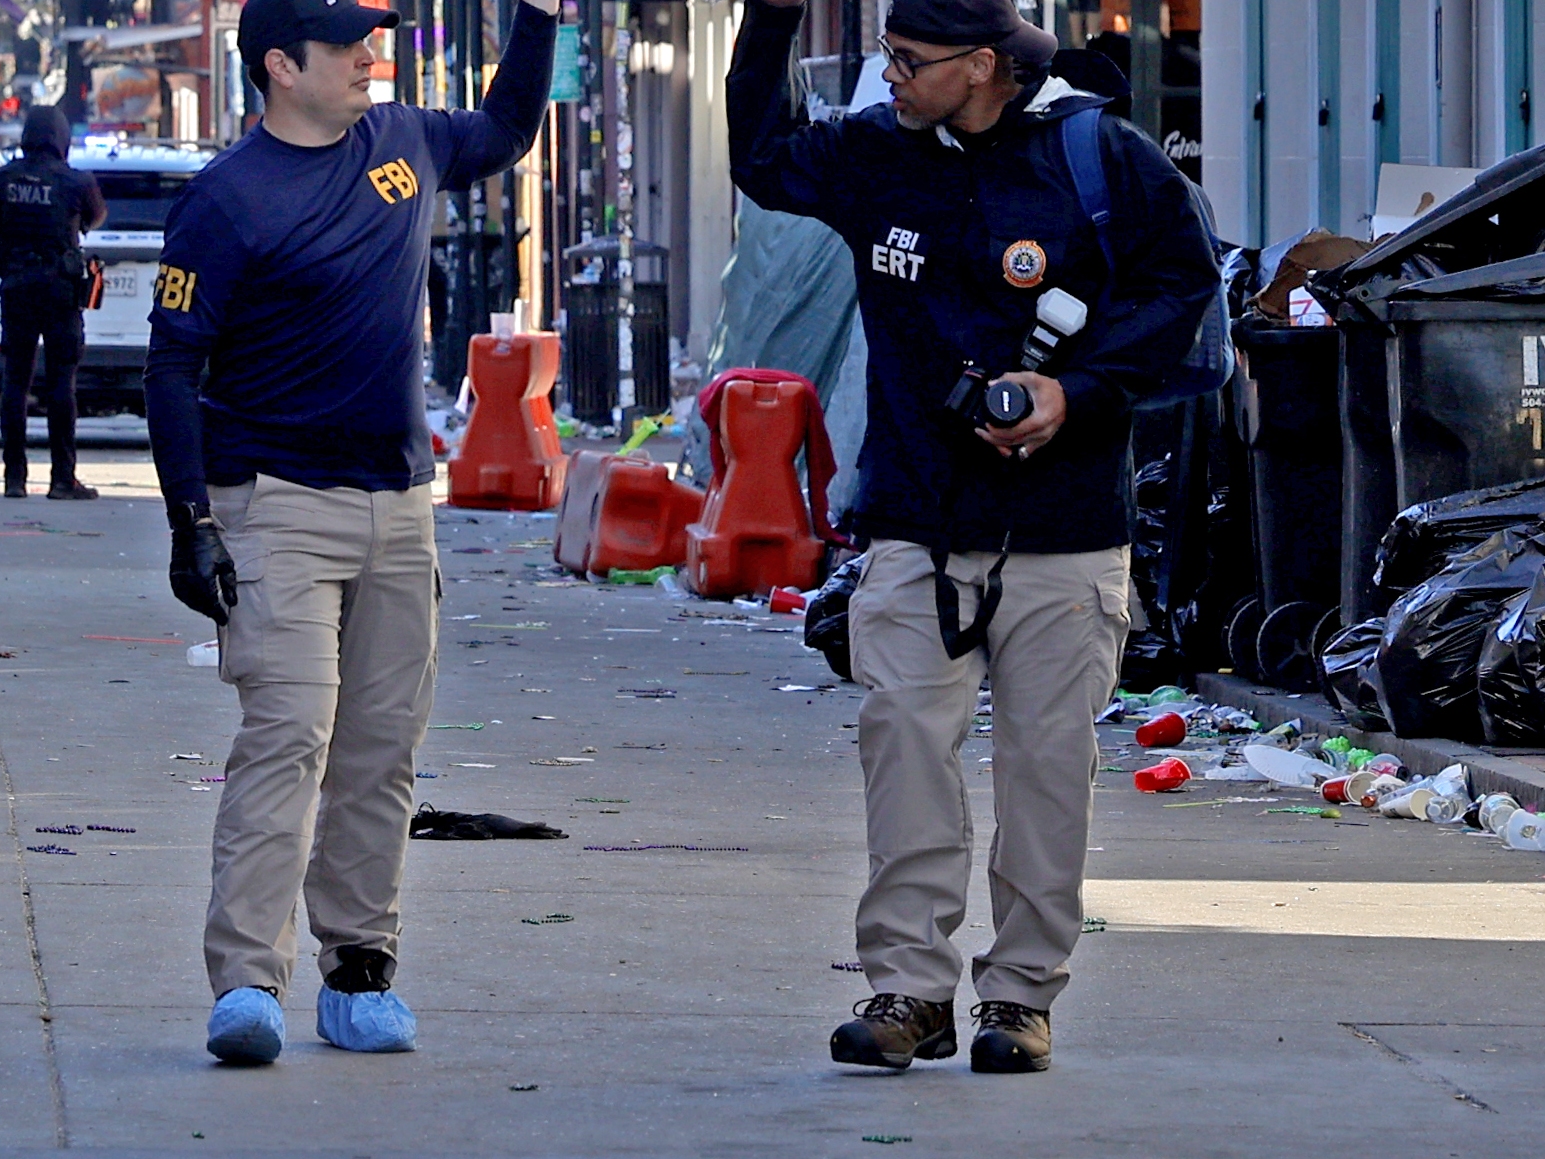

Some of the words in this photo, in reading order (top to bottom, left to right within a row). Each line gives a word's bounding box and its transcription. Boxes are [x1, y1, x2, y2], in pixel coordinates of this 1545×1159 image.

[368, 157, 419, 205] FBI
[886, 226, 920, 251] FBI
[872, 244, 925, 282] ERT
[154, 263, 197, 313] FBI
